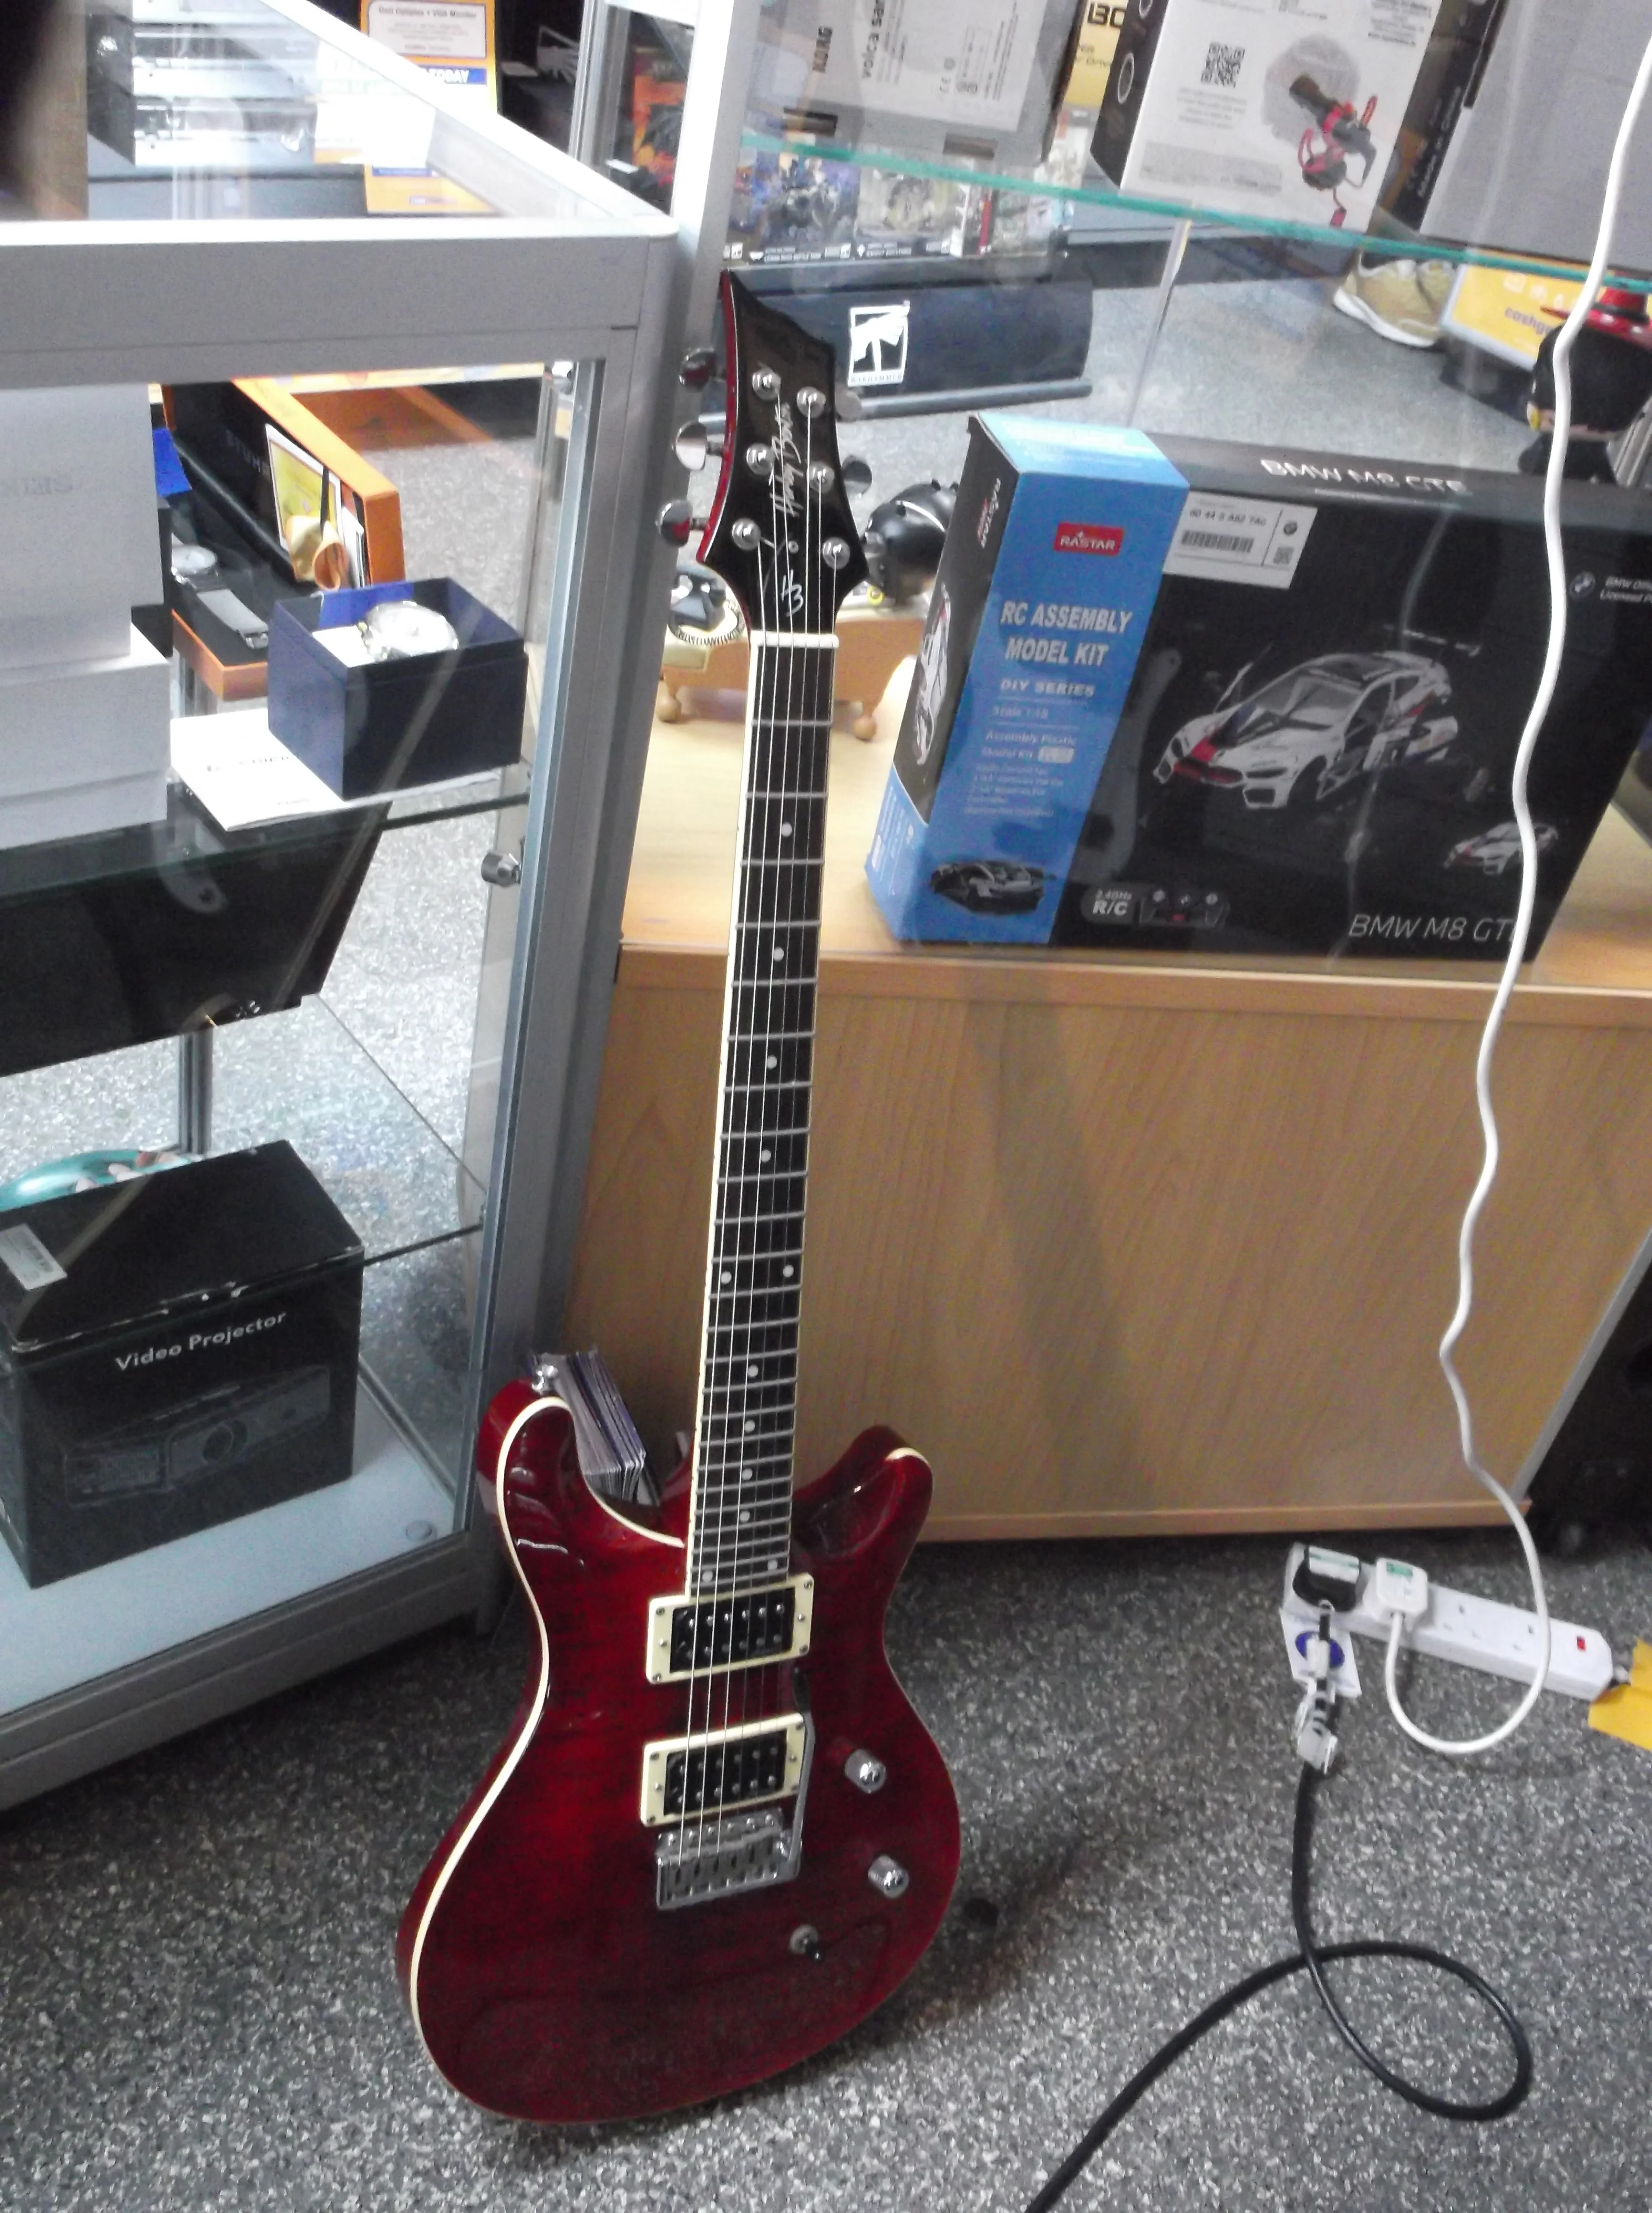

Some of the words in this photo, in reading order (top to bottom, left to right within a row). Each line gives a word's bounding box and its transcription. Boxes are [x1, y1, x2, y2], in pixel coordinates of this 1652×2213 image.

[862, 32, 879, 78] volca
[850, 375, 903, 383] WARHAMMER
[1260, 459, 1342, 482] BMW
[1347, 469, 1400, 488] M8
[1060, 533, 1116, 551] RASTAR
[1000, 600, 1028, 626] RC
[1031, 602, 1133, 634] ASSEMBLY
[1005, 637, 1069, 665] MODEL
[1073, 642, 1110, 666] KIT
[1000, 678, 1029, 692] DIY
[1034, 681, 1095, 697] SERIES
[985, 730, 1038, 744] Assembly
[1092, 900, 1128, 916] R/C
[1348, 913, 1422, 939] BMW
[1423, 917, 1467, 941] M8
[1473, 918, 1515, 942] GT
[115, 1346, 182, 1370] Video
[189, 1312, 287, 1350] Projector
